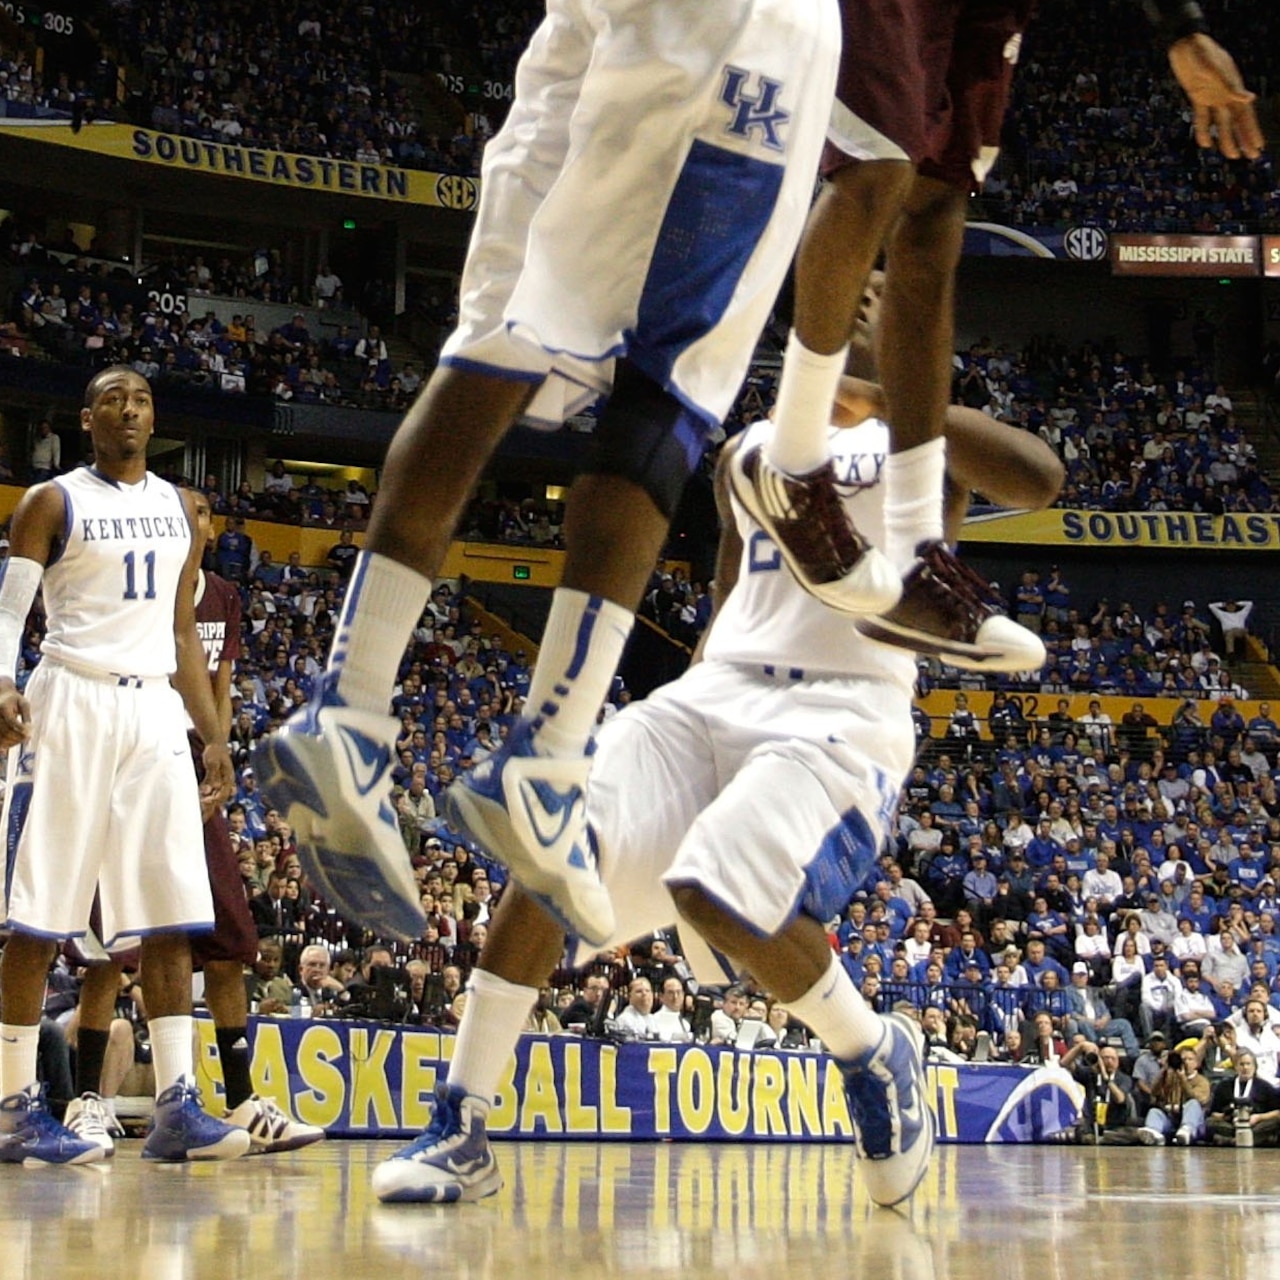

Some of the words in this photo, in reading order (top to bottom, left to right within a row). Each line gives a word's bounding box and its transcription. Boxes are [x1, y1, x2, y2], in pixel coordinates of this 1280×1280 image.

[44, 11, 74, 35] 305
[721, 64, 791, 153] UK
[133, 125, 410, 199] SOUTHEASTERN
[439, 175, 477, 210] SEC
[1069, 226, 1104, 260] SEC
[1119, 245, 1207, 263] MISSISSIPPI
[1207, 246, 1254, 264] STATE
[147, 290, 187, 315] 205
[82, 517, 188, 542] KENTUCKY
[122, 550, 157, 600] 11
